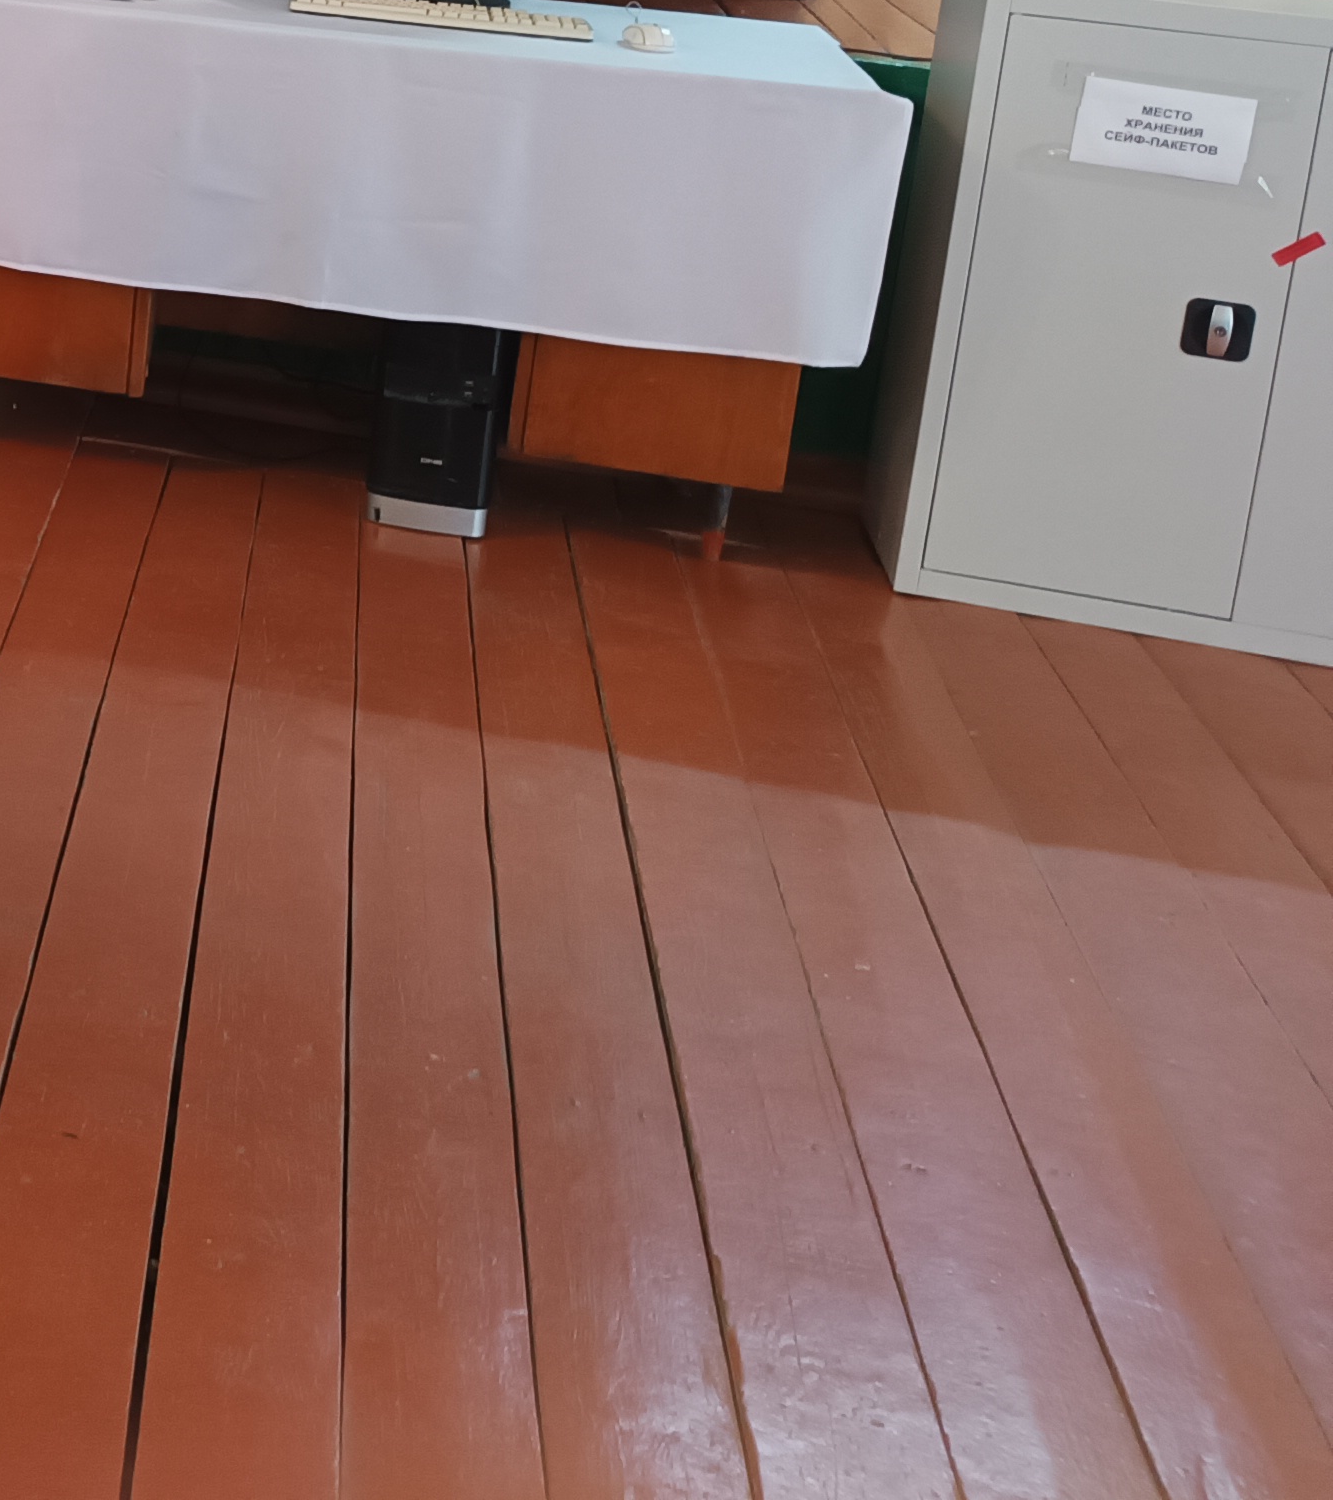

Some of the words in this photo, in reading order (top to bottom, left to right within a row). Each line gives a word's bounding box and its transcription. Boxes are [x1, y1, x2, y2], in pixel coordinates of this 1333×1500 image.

[1141, 105, 1193, 121] МЕСТО
[1124, 118, 1204, 138] ХРАНЕНИЯ
[1104, 130, 1219, 156] СЕЙФ-ПАКЕТОВ
